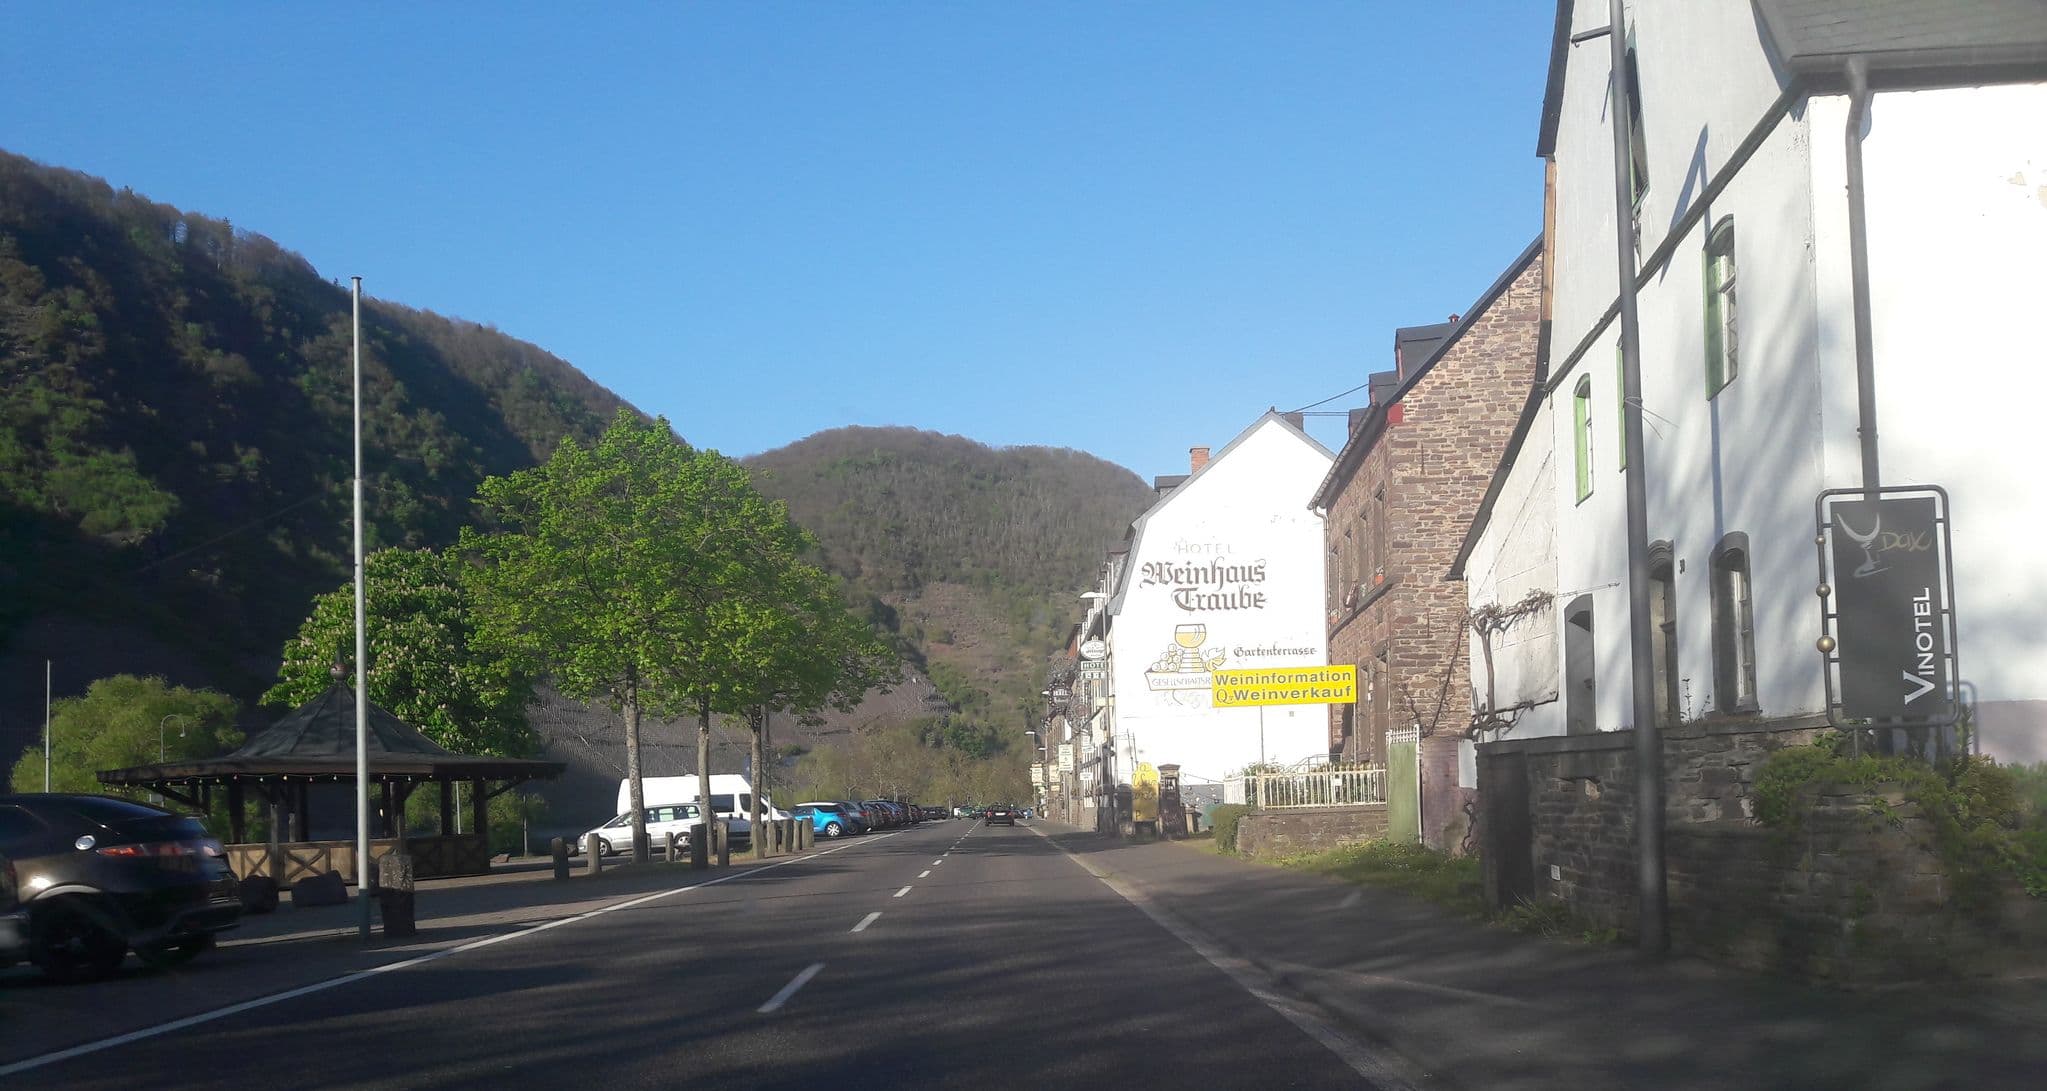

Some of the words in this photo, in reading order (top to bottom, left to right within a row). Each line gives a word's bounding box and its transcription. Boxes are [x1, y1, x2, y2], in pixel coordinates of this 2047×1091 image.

[1178, 543, 1236, 554] HOTEL
[1139, 556, 1267, 589] Weinhaus
[1172, 585, 1267, 612] Traube
[1233, 642, 1317, 658] Gartenterrasse
[1215, 670, 1351, 686] Weininformation
